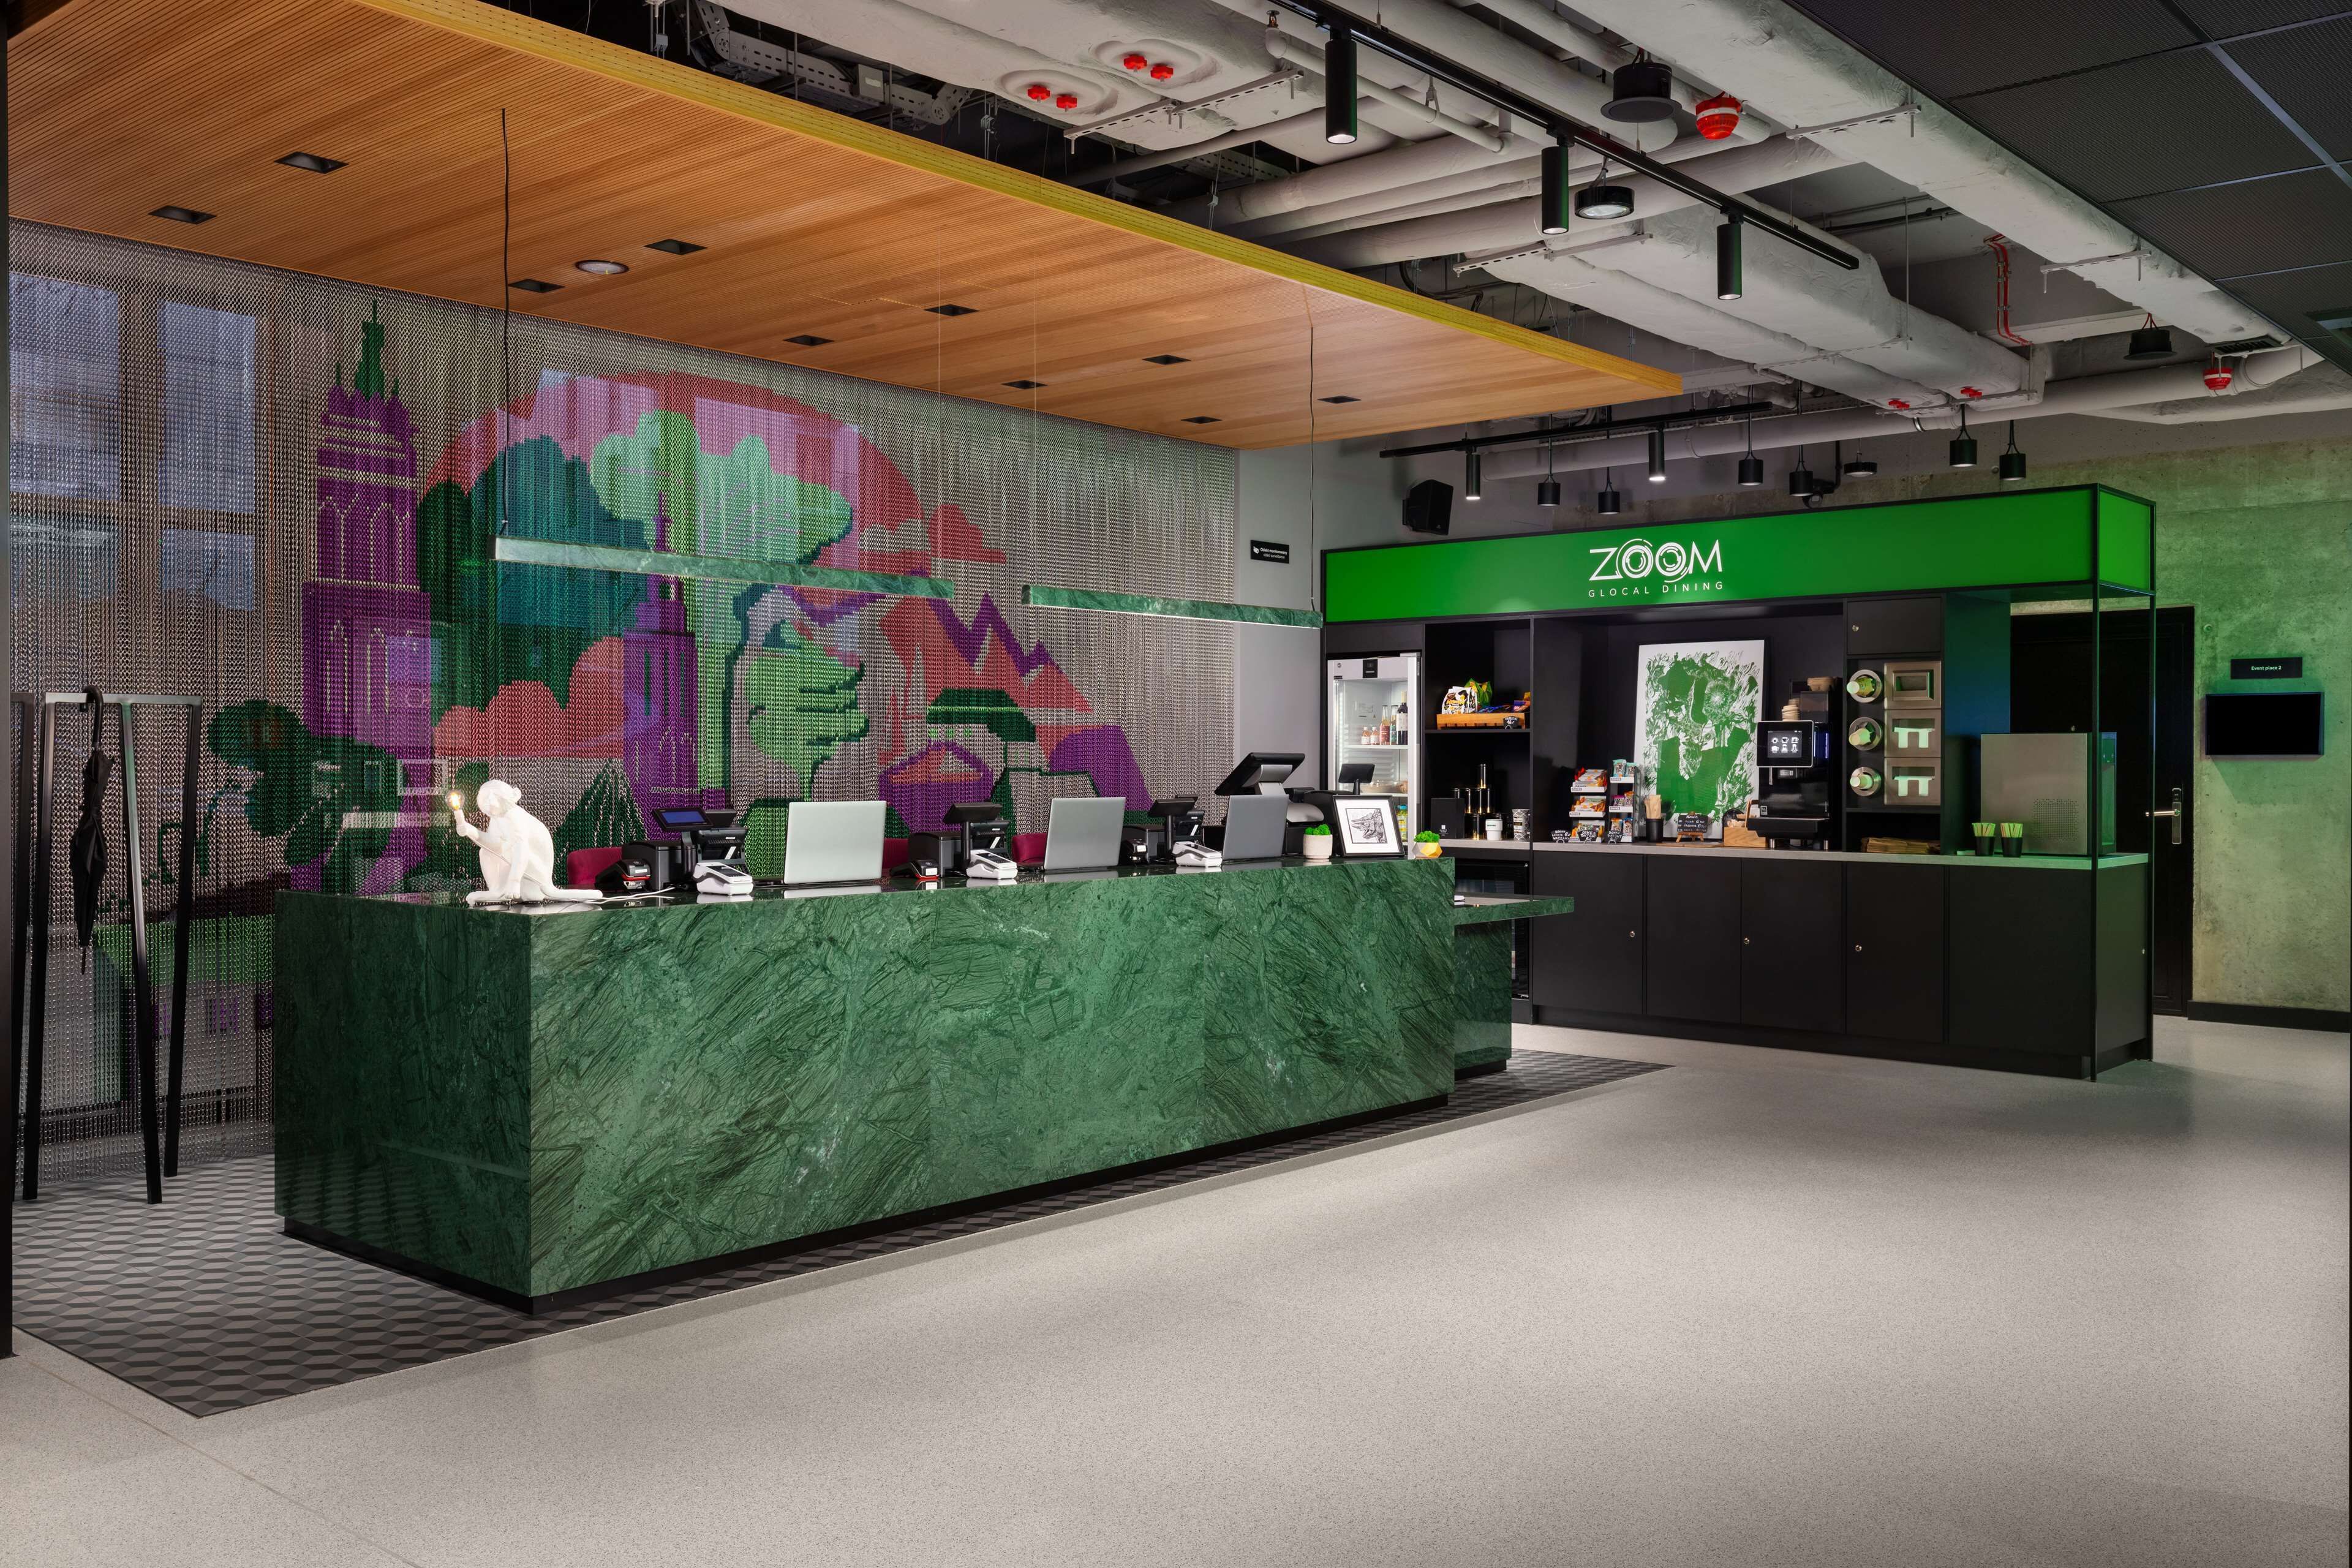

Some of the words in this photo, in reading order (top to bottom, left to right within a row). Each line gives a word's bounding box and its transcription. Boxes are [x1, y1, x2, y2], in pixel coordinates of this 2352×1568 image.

[1589, 538, 1722, 582] ZOOM
[1588, 586, 1649, 598] GLOCAL
[1662, 581, 1723, 594] DINING
